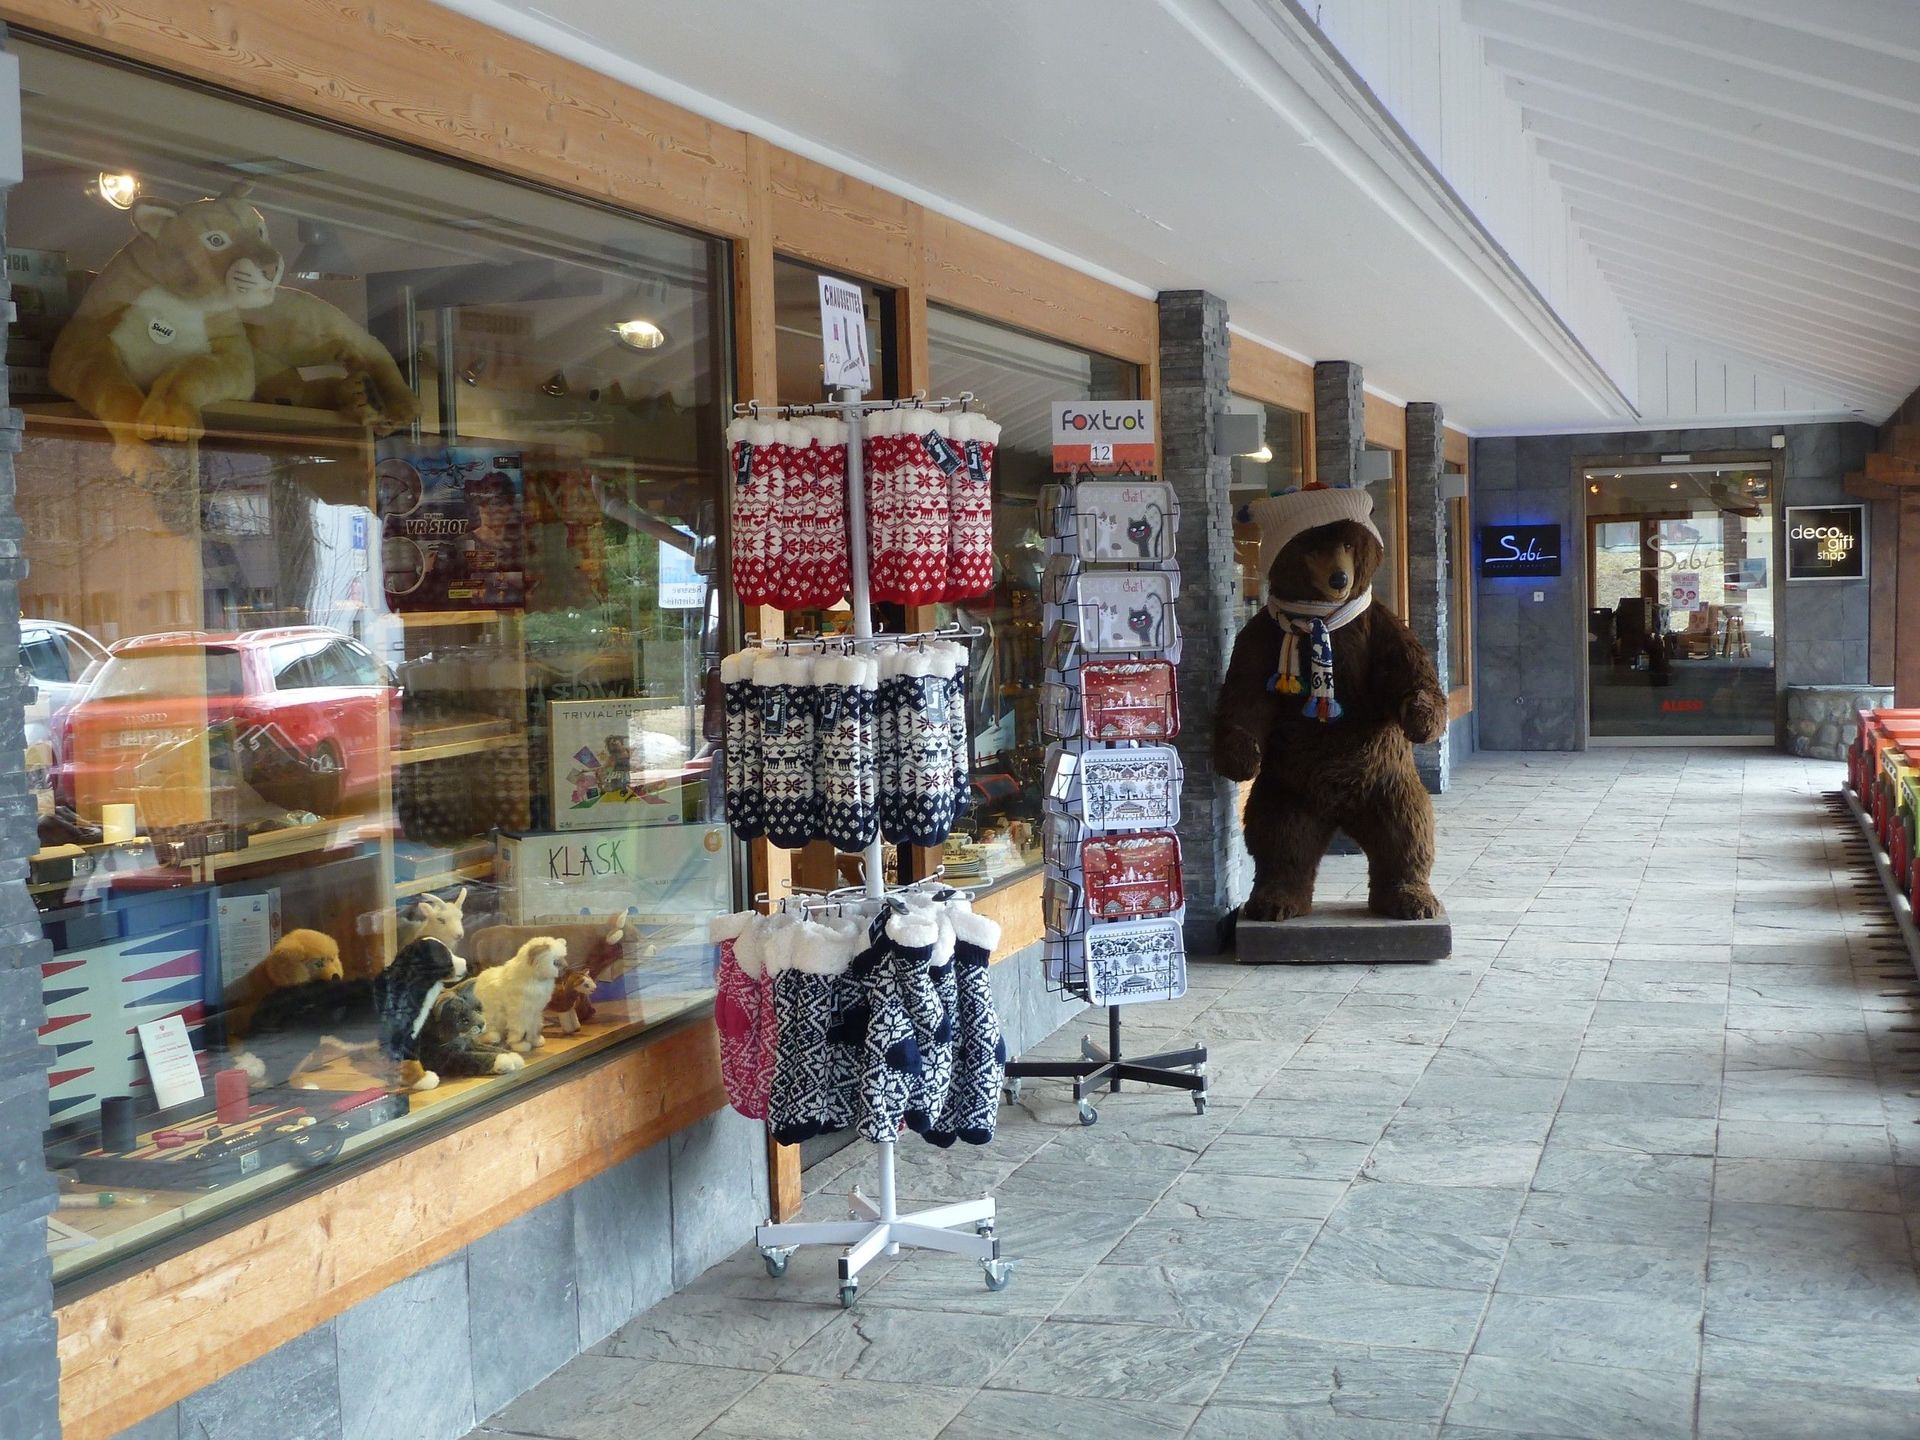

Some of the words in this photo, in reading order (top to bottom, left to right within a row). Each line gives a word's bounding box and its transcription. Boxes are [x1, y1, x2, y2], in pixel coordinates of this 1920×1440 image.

[1092, 445, 1110, 460] 12
[406, 520, 429, 535] VR
[427, 519, 469, 535] SHOT
[1790, 524, 1840, 540] deco
[1485, 535, 1558, 564] Sabi
[1827, 535, 1855, 552] gift
[1622, 534, 1737, 574] Sabi
[1817, 551, 1847, 562] shop
[563, 710, 613, 721] TRIVIAL
[549, 840, 625, 880] KLASK
